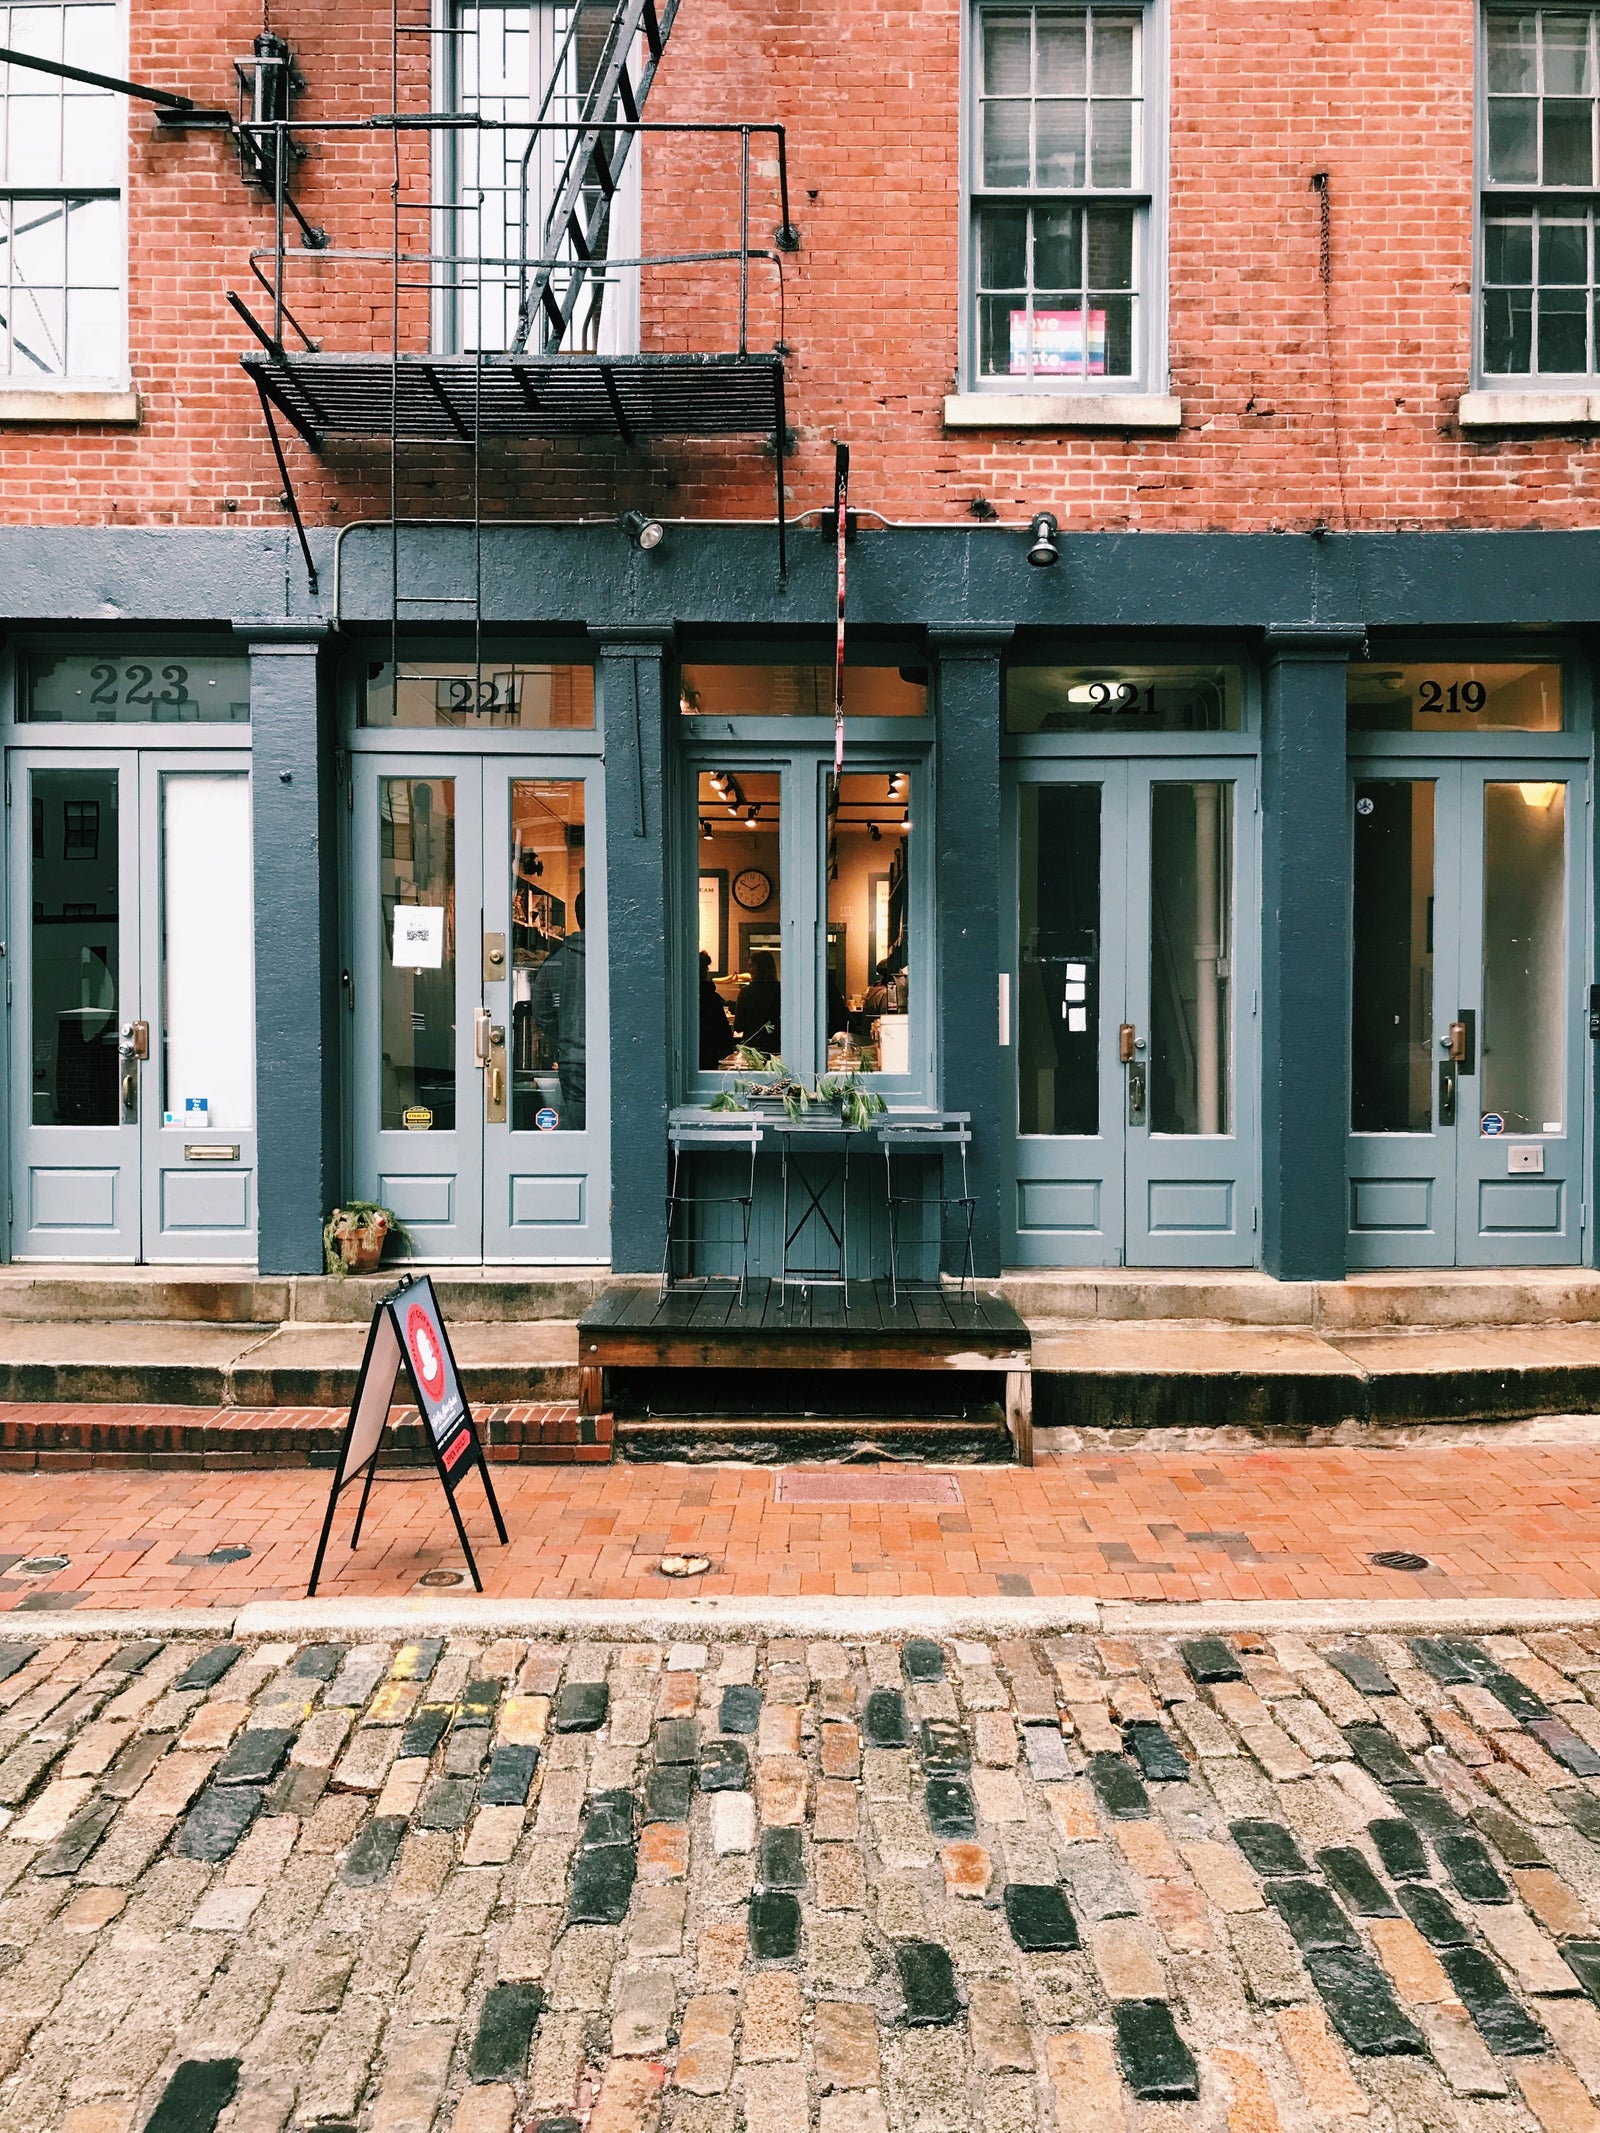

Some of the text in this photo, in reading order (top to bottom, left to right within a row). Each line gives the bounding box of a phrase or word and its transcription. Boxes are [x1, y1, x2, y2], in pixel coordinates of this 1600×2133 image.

[89, 664, 189, 705] 223
[449, 681, 519, 713] 221
[1088, 682, 1160, 715] 221
[1418, 680, 1487, 713] 219
